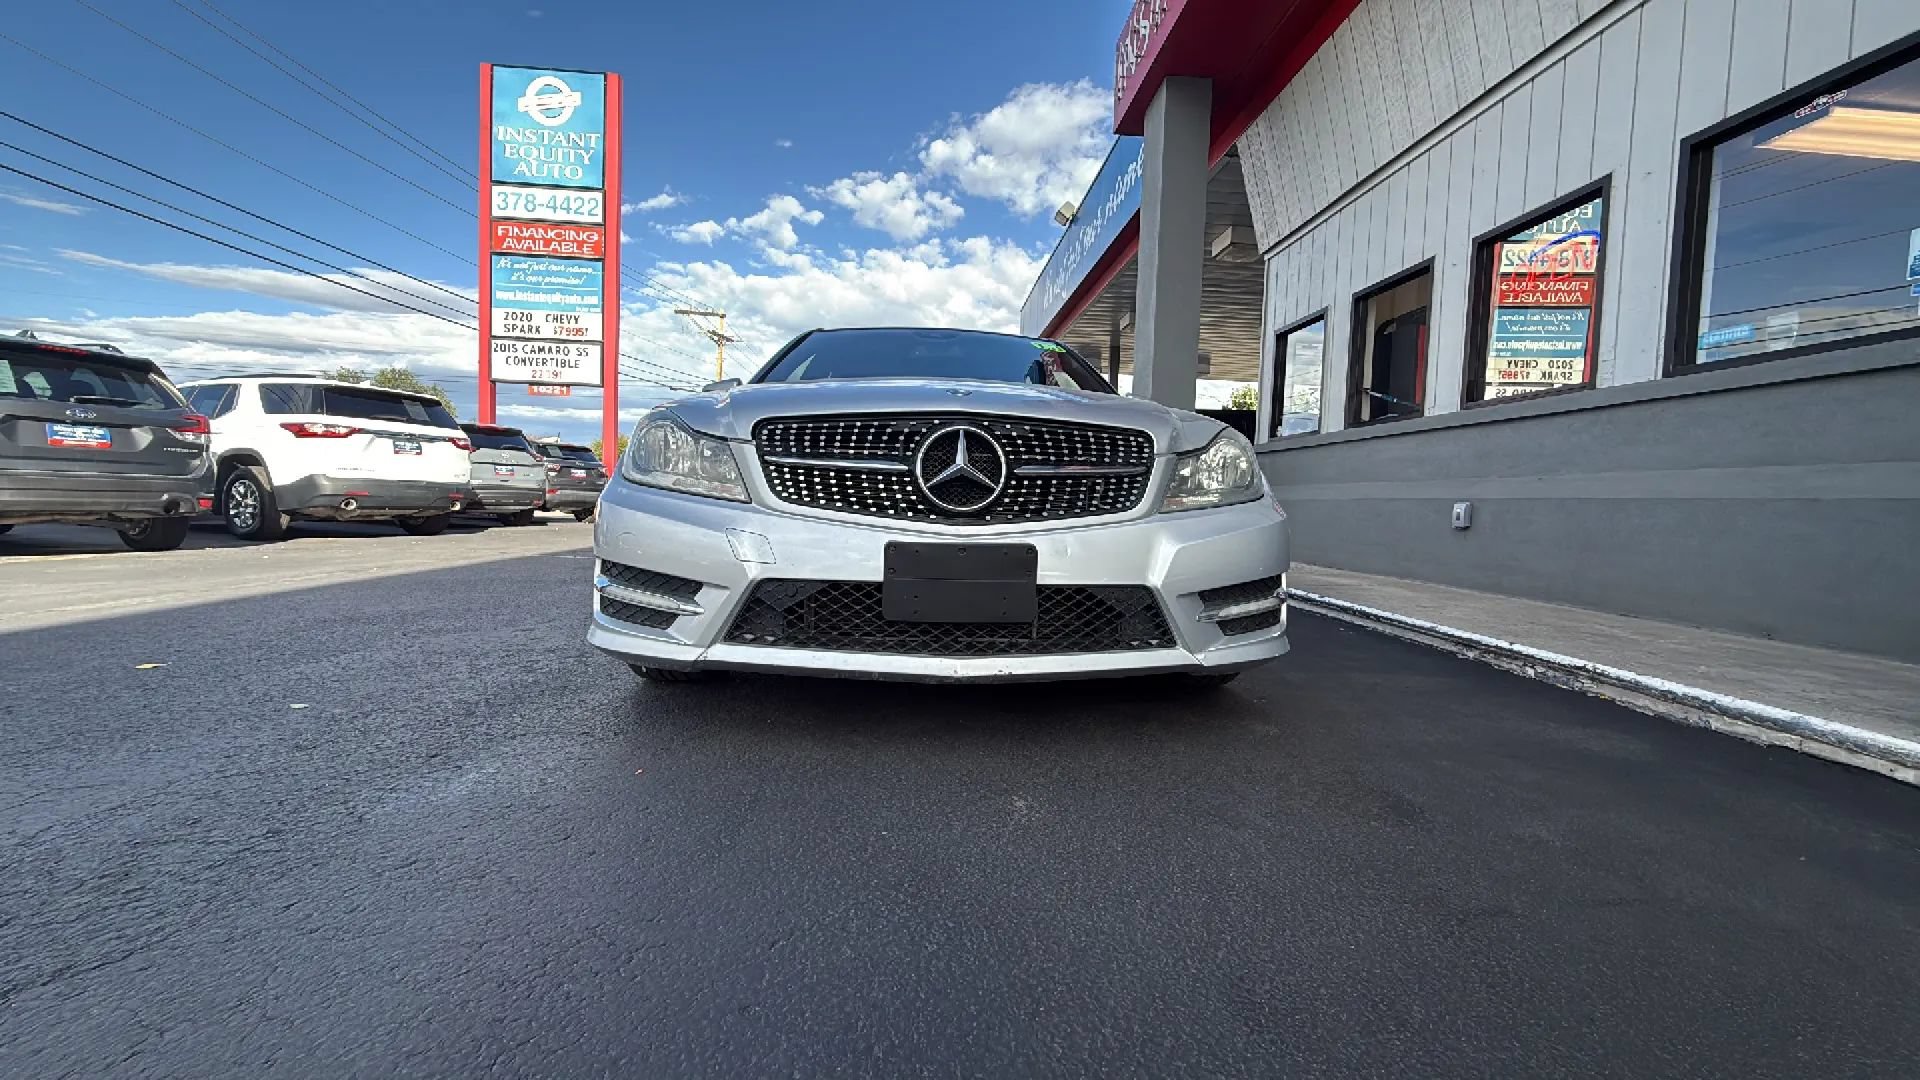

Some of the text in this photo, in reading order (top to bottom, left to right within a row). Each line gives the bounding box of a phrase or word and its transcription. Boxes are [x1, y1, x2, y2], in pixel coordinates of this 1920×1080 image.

[497, 126, 600, 148] INSTANT
[504, 143, 595, 165] EQUITY
[513, 160, 583, 180] AUTO
[496, 191, 599, 217] 378-4422
[497, 226, 599, 242] FINANCING
[502, 238, 595, 254] AVAILABLE
[504, 312, 580, 325] 2020 CHEVY
[503, 323, 589, 337] SPARK $7995!
[493, 342, 589, 357] 2015 CAMARO SS
[505, 356, 581, 369] CONVERTIBLE
